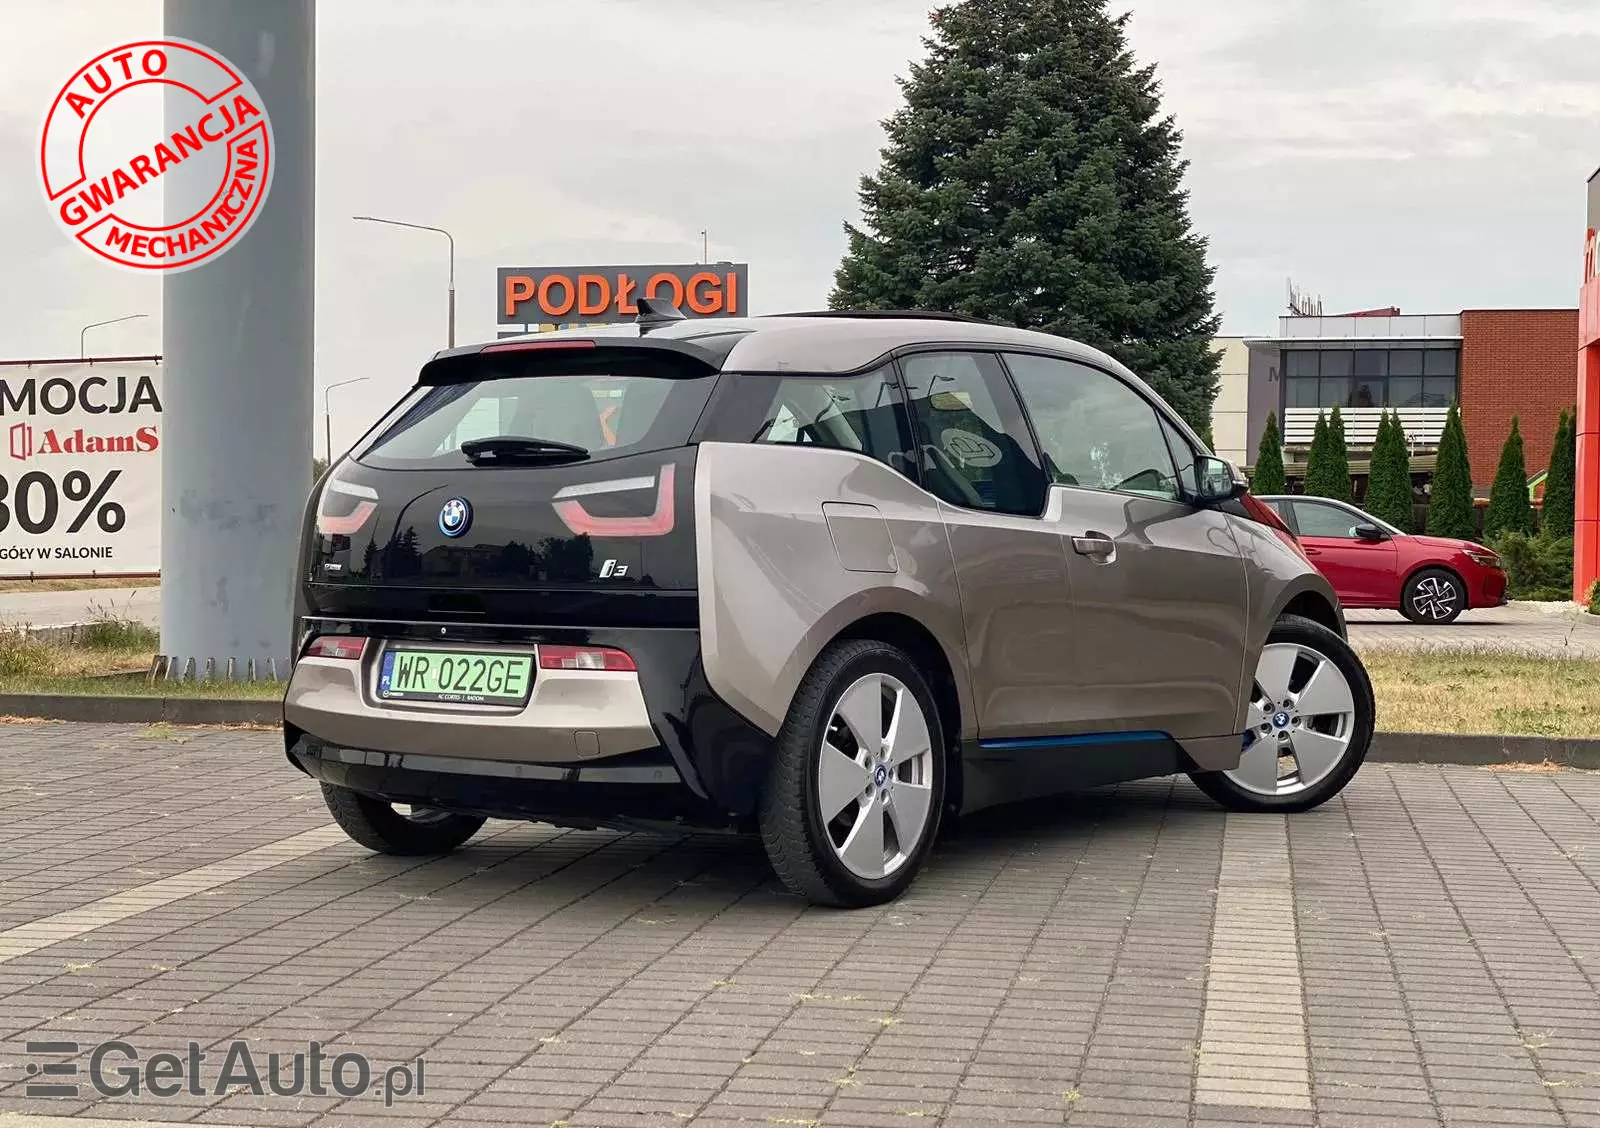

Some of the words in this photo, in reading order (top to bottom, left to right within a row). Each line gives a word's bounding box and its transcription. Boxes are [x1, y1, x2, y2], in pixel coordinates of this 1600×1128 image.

[505, 271, 737, 316] PODŁOGI
[0, 376, 163, 416] MOCJA
[37, 425, 159, 454] AdamS
[0, 545, 34, 560] GÓŁY
[37, 547, 51, 559] W
[55, 546, 113, 559] SALONIE
[397, 655, 430, 689] WR
[438, 657, 523, 694] 022GE
